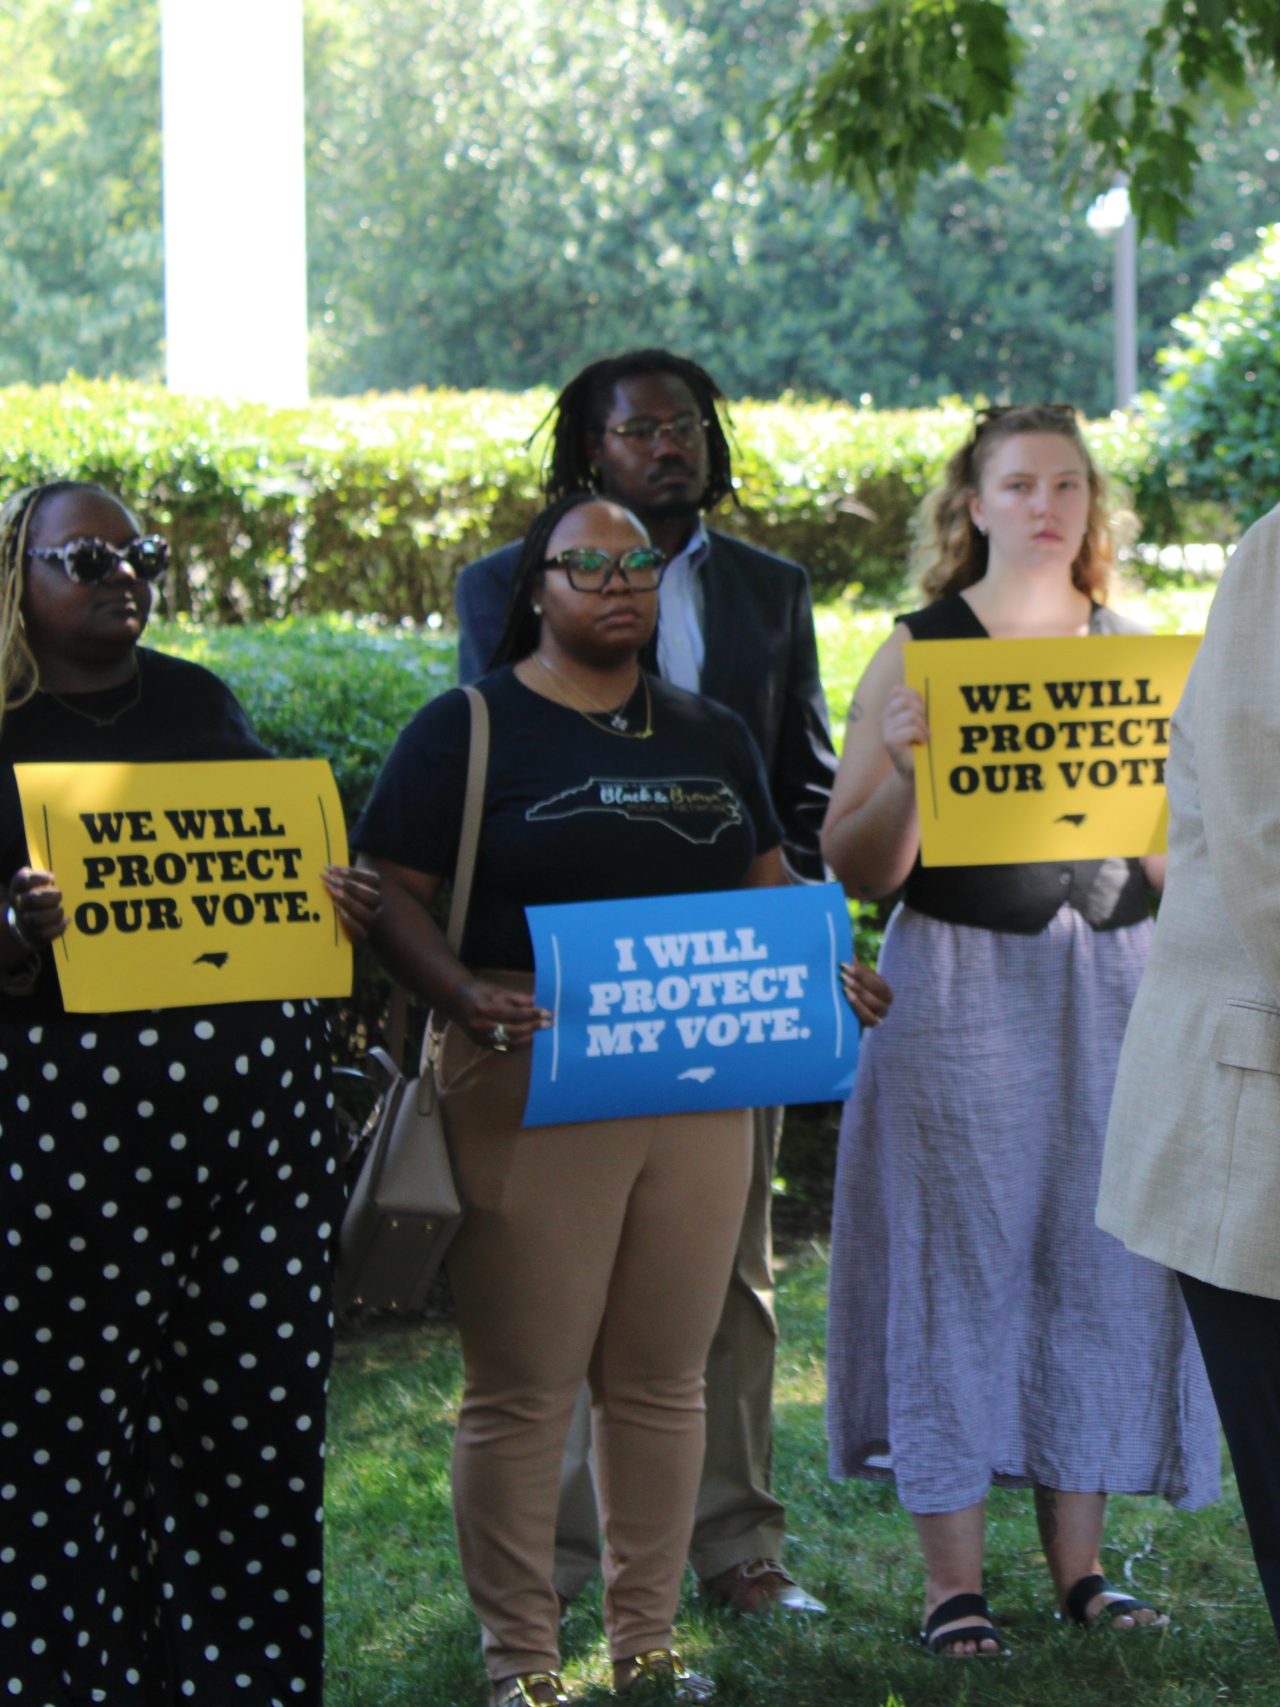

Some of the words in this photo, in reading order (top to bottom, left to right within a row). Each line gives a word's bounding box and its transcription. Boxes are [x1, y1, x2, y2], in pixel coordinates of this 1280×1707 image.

[959, 683, 1032, 714] WE
[1043, 679, 1160, 710] WILL
[959, 718, 1170, 754] PROTECT
[949, 763, 1044, 796] OUR
[79, 810, 157, 844] WE
[164, 807, 286, 840] WILL
[82, 848, 302, 889] PROTECT
[74, 898, 183, 936] OUR
[191, 891, 321, 927] VOTE.
[614, 937, 637, 972] I
[644, 927, 769, 969] WILL
[589, 964, 809, 1016] PROTECT
[586, 1019, 666, 1057] MY
[675, 1007, 812, 1049] VOTE.
